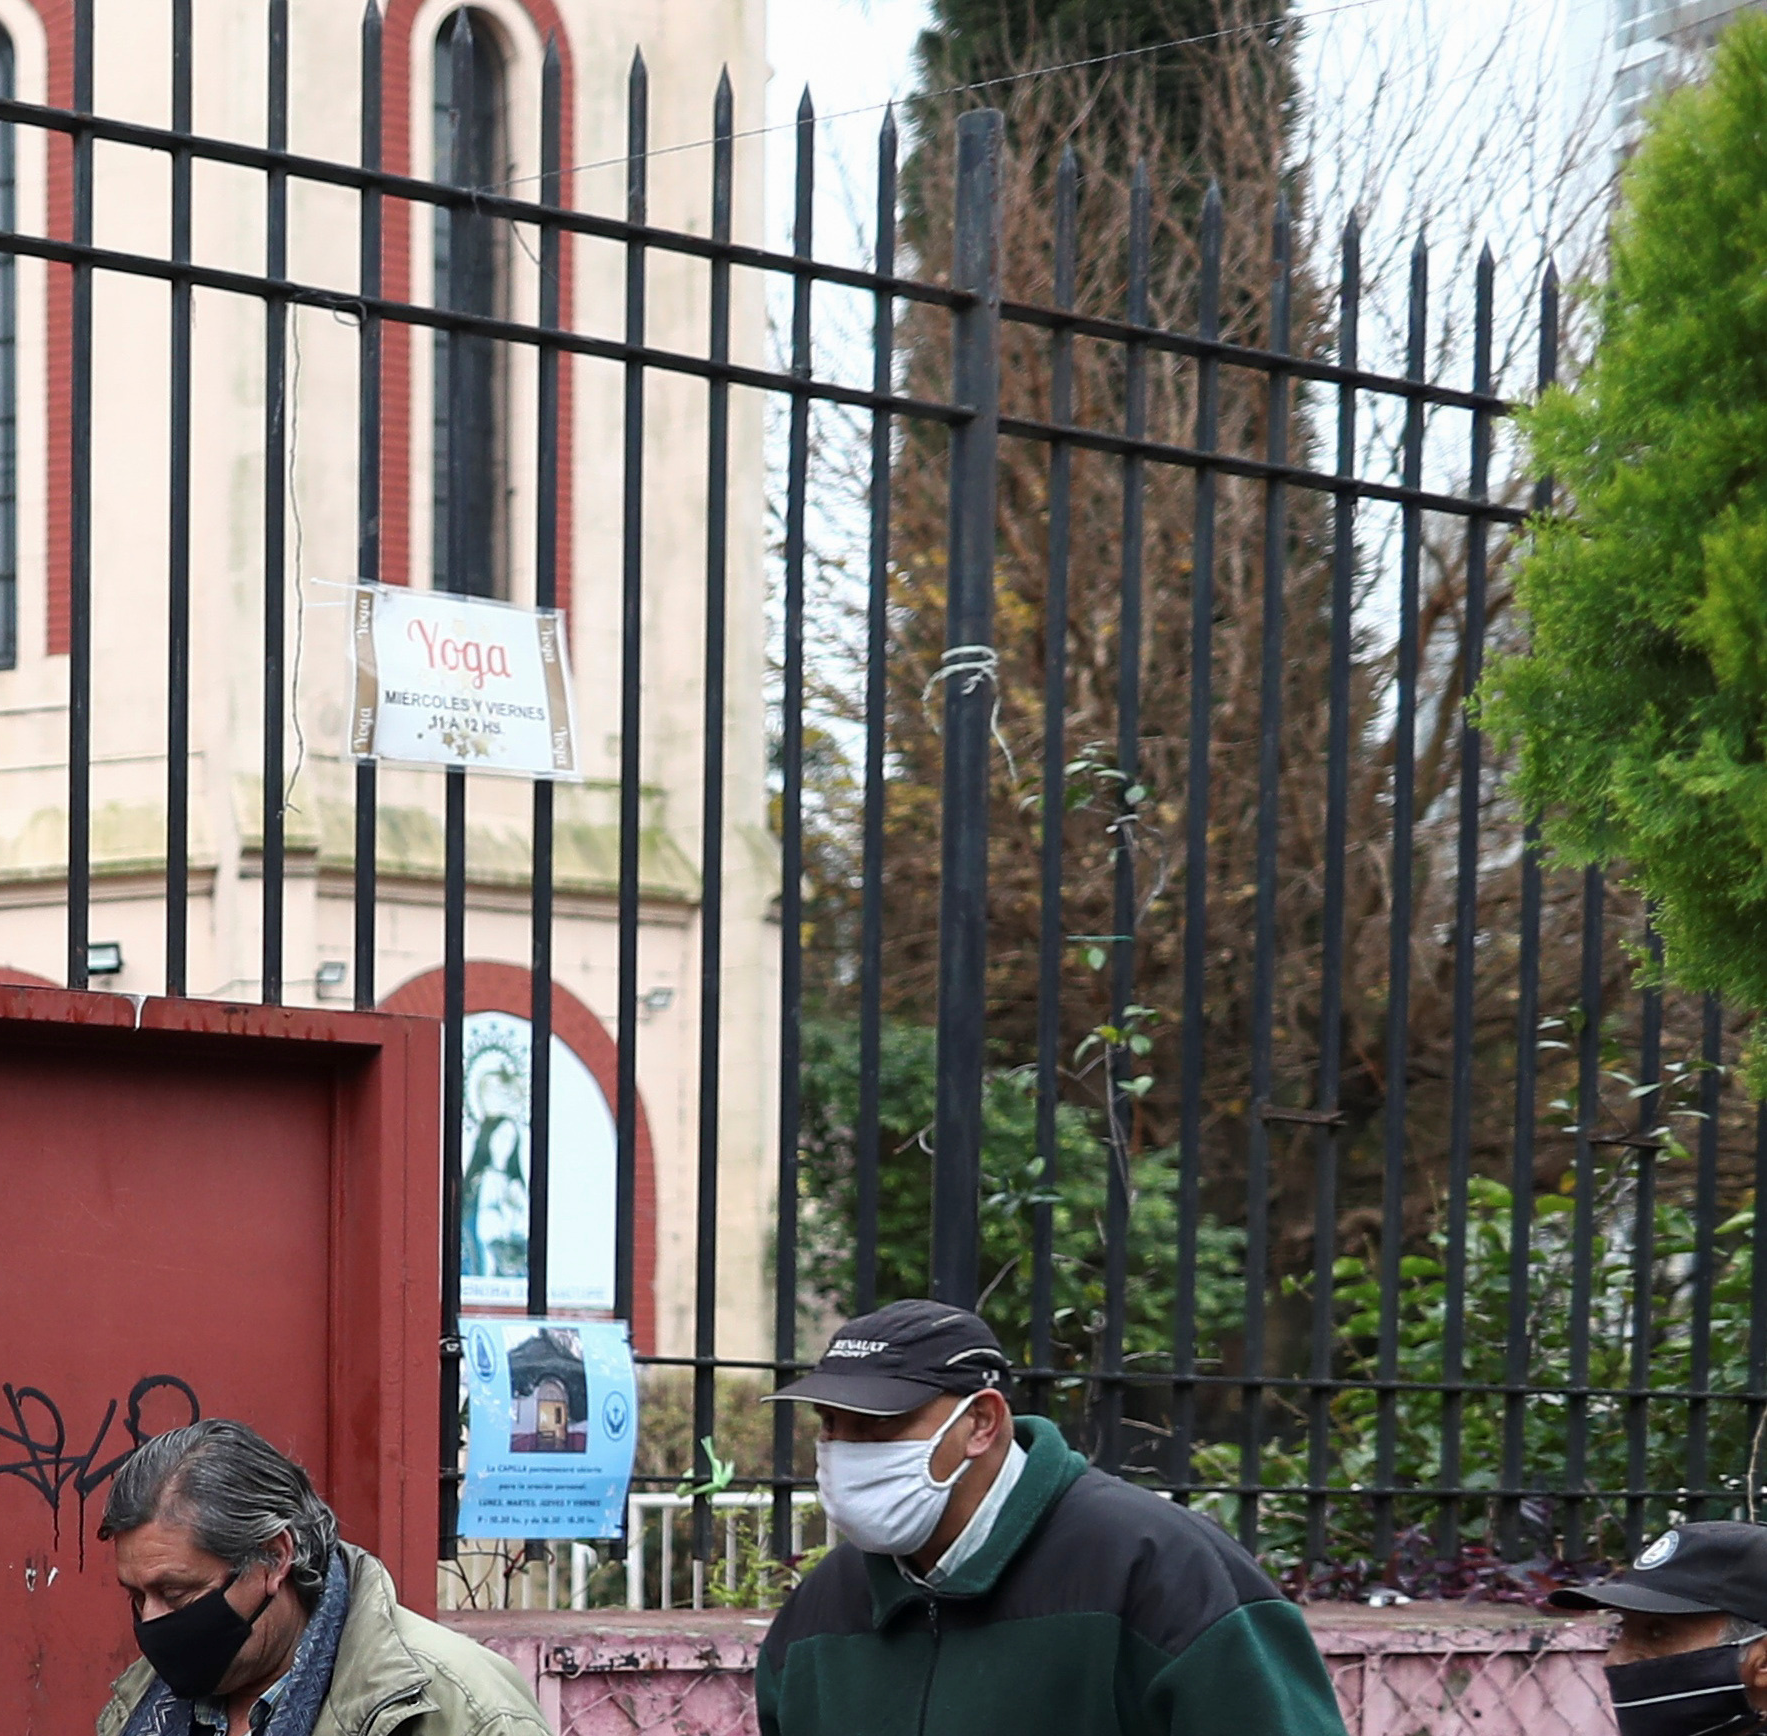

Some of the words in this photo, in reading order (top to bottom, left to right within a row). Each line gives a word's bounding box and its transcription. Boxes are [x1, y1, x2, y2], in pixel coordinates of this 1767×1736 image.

[407, 618, 512, 689] Yoga
[473, 700, 482, 713] Y
[488, 702, 546, 721] VIERNES
[449, 717, 459, 730] A
